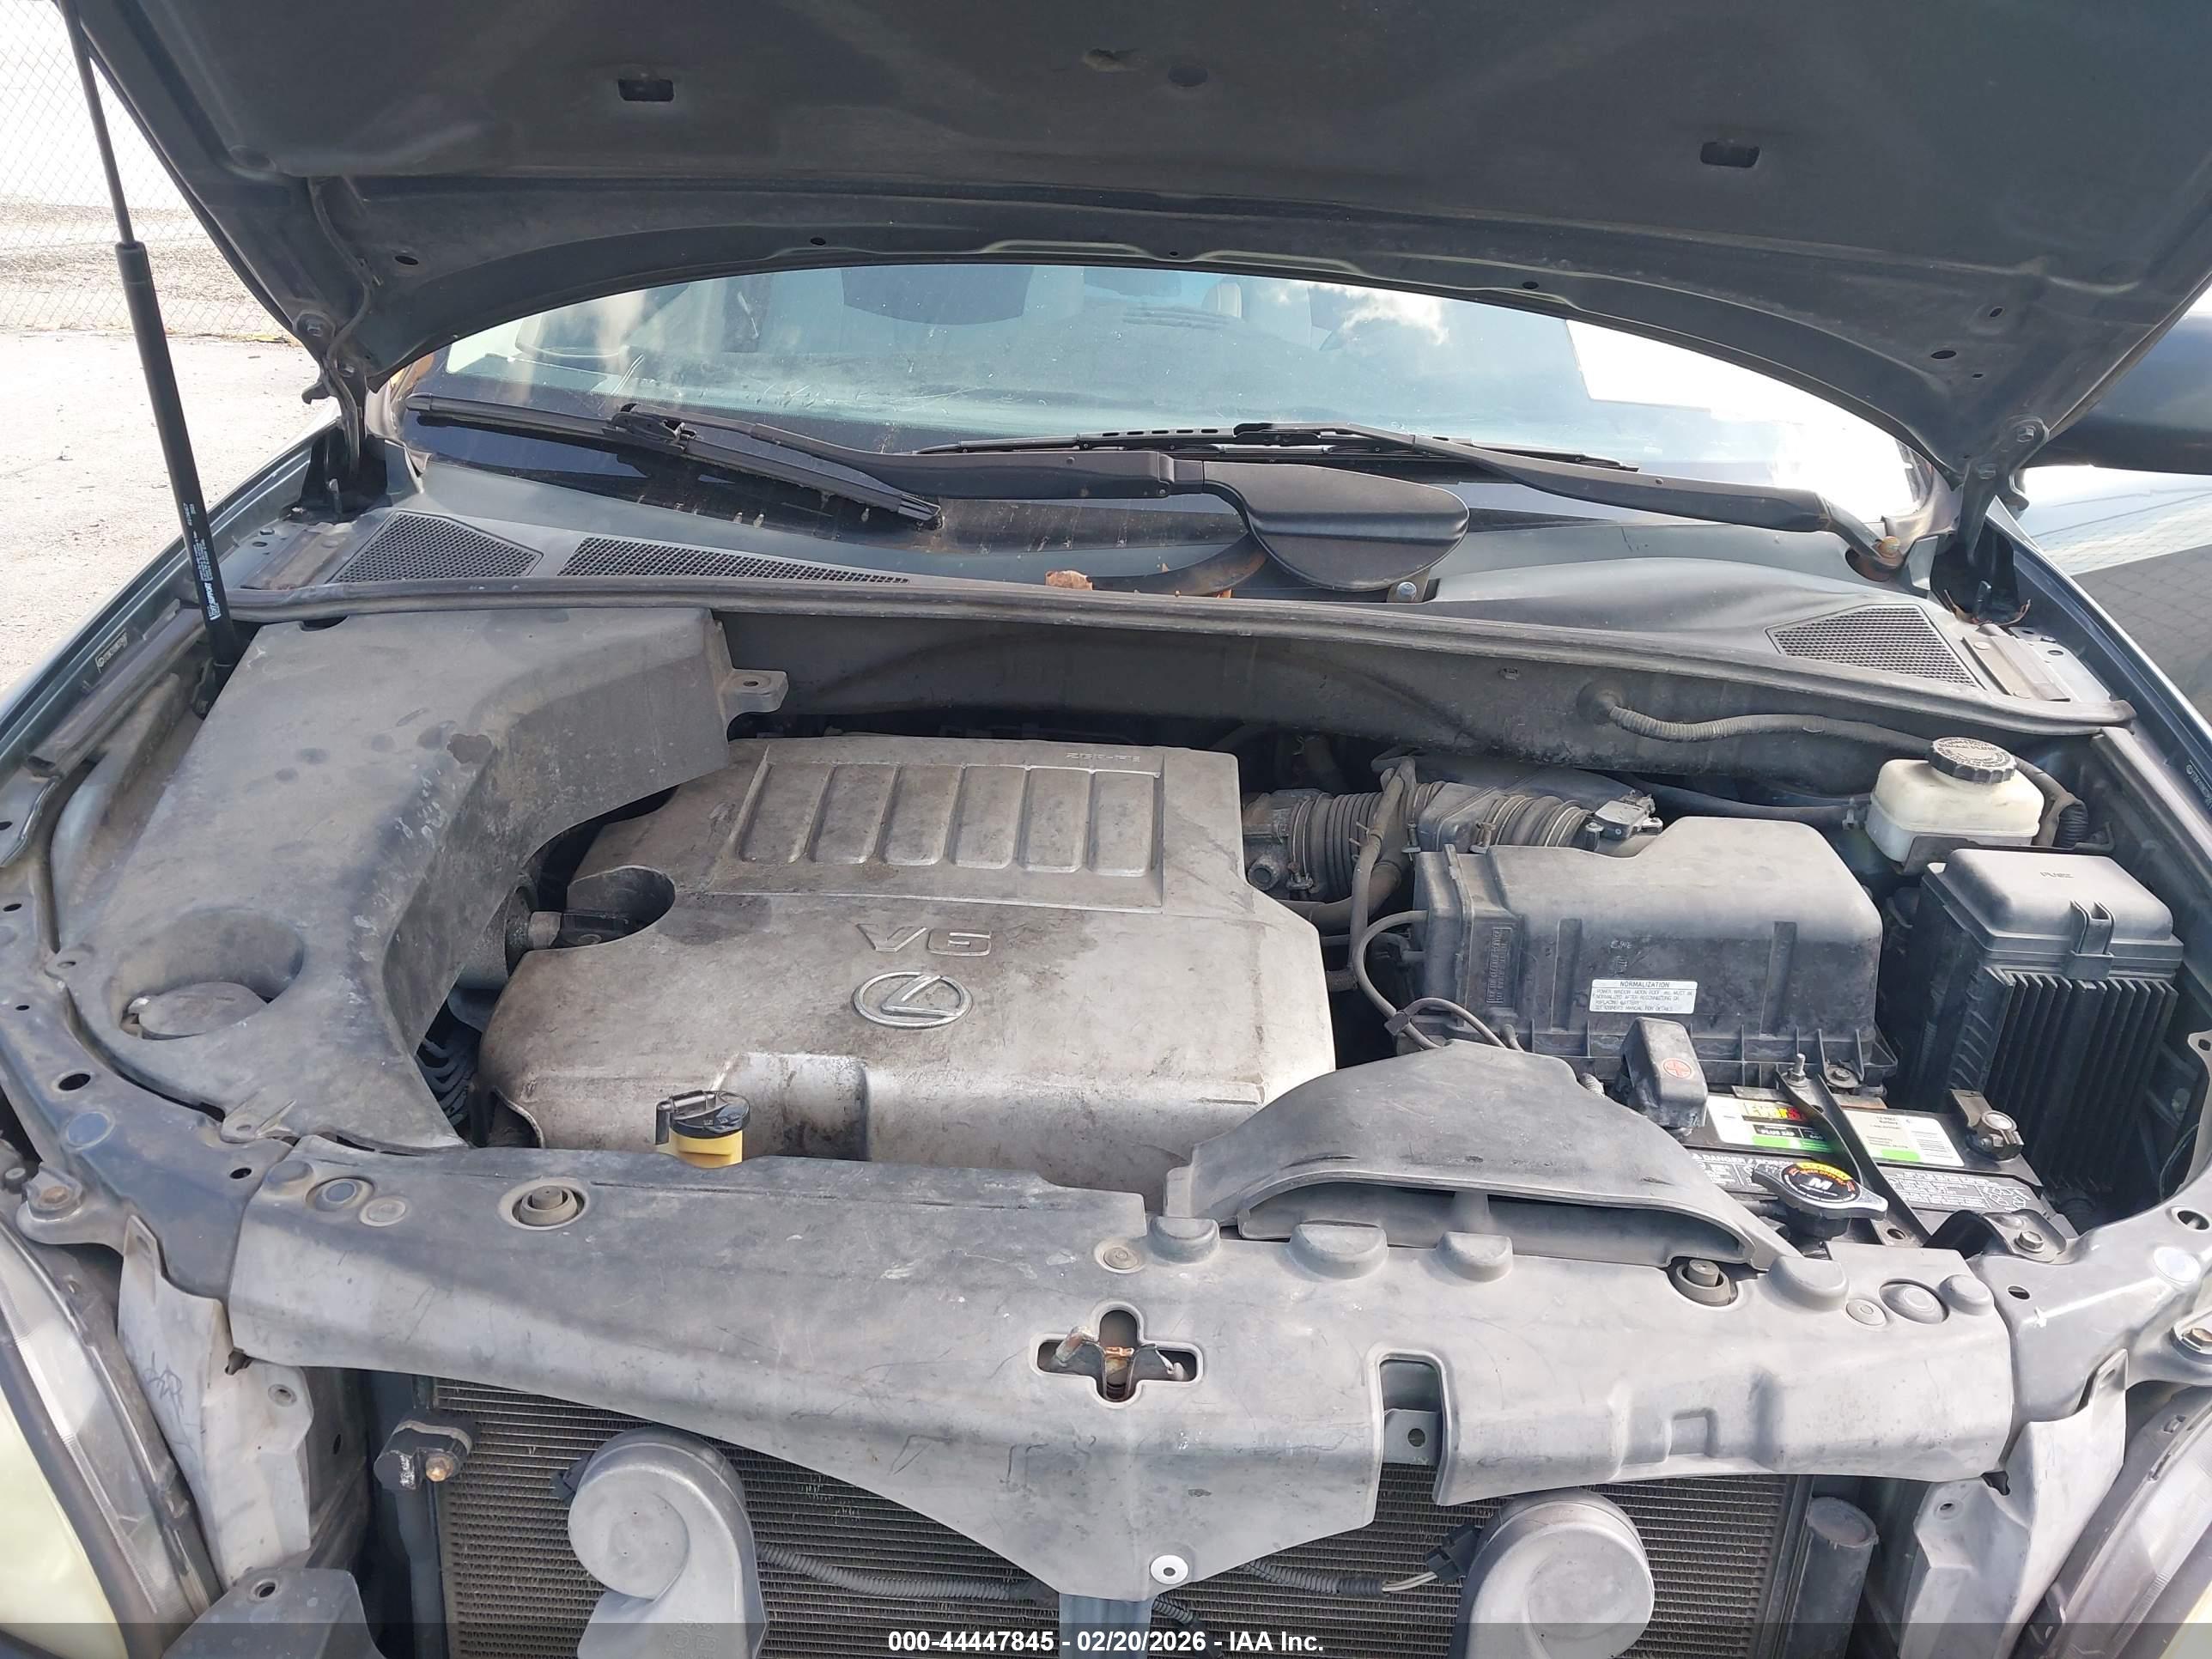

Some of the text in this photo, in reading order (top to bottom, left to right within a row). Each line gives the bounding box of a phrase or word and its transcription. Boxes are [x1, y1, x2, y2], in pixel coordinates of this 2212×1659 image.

[855, 922, 992, 957] V6
[1703, 1155, 1746, 1164] DANGER
[1808, 1177, 1834, 1190] M
